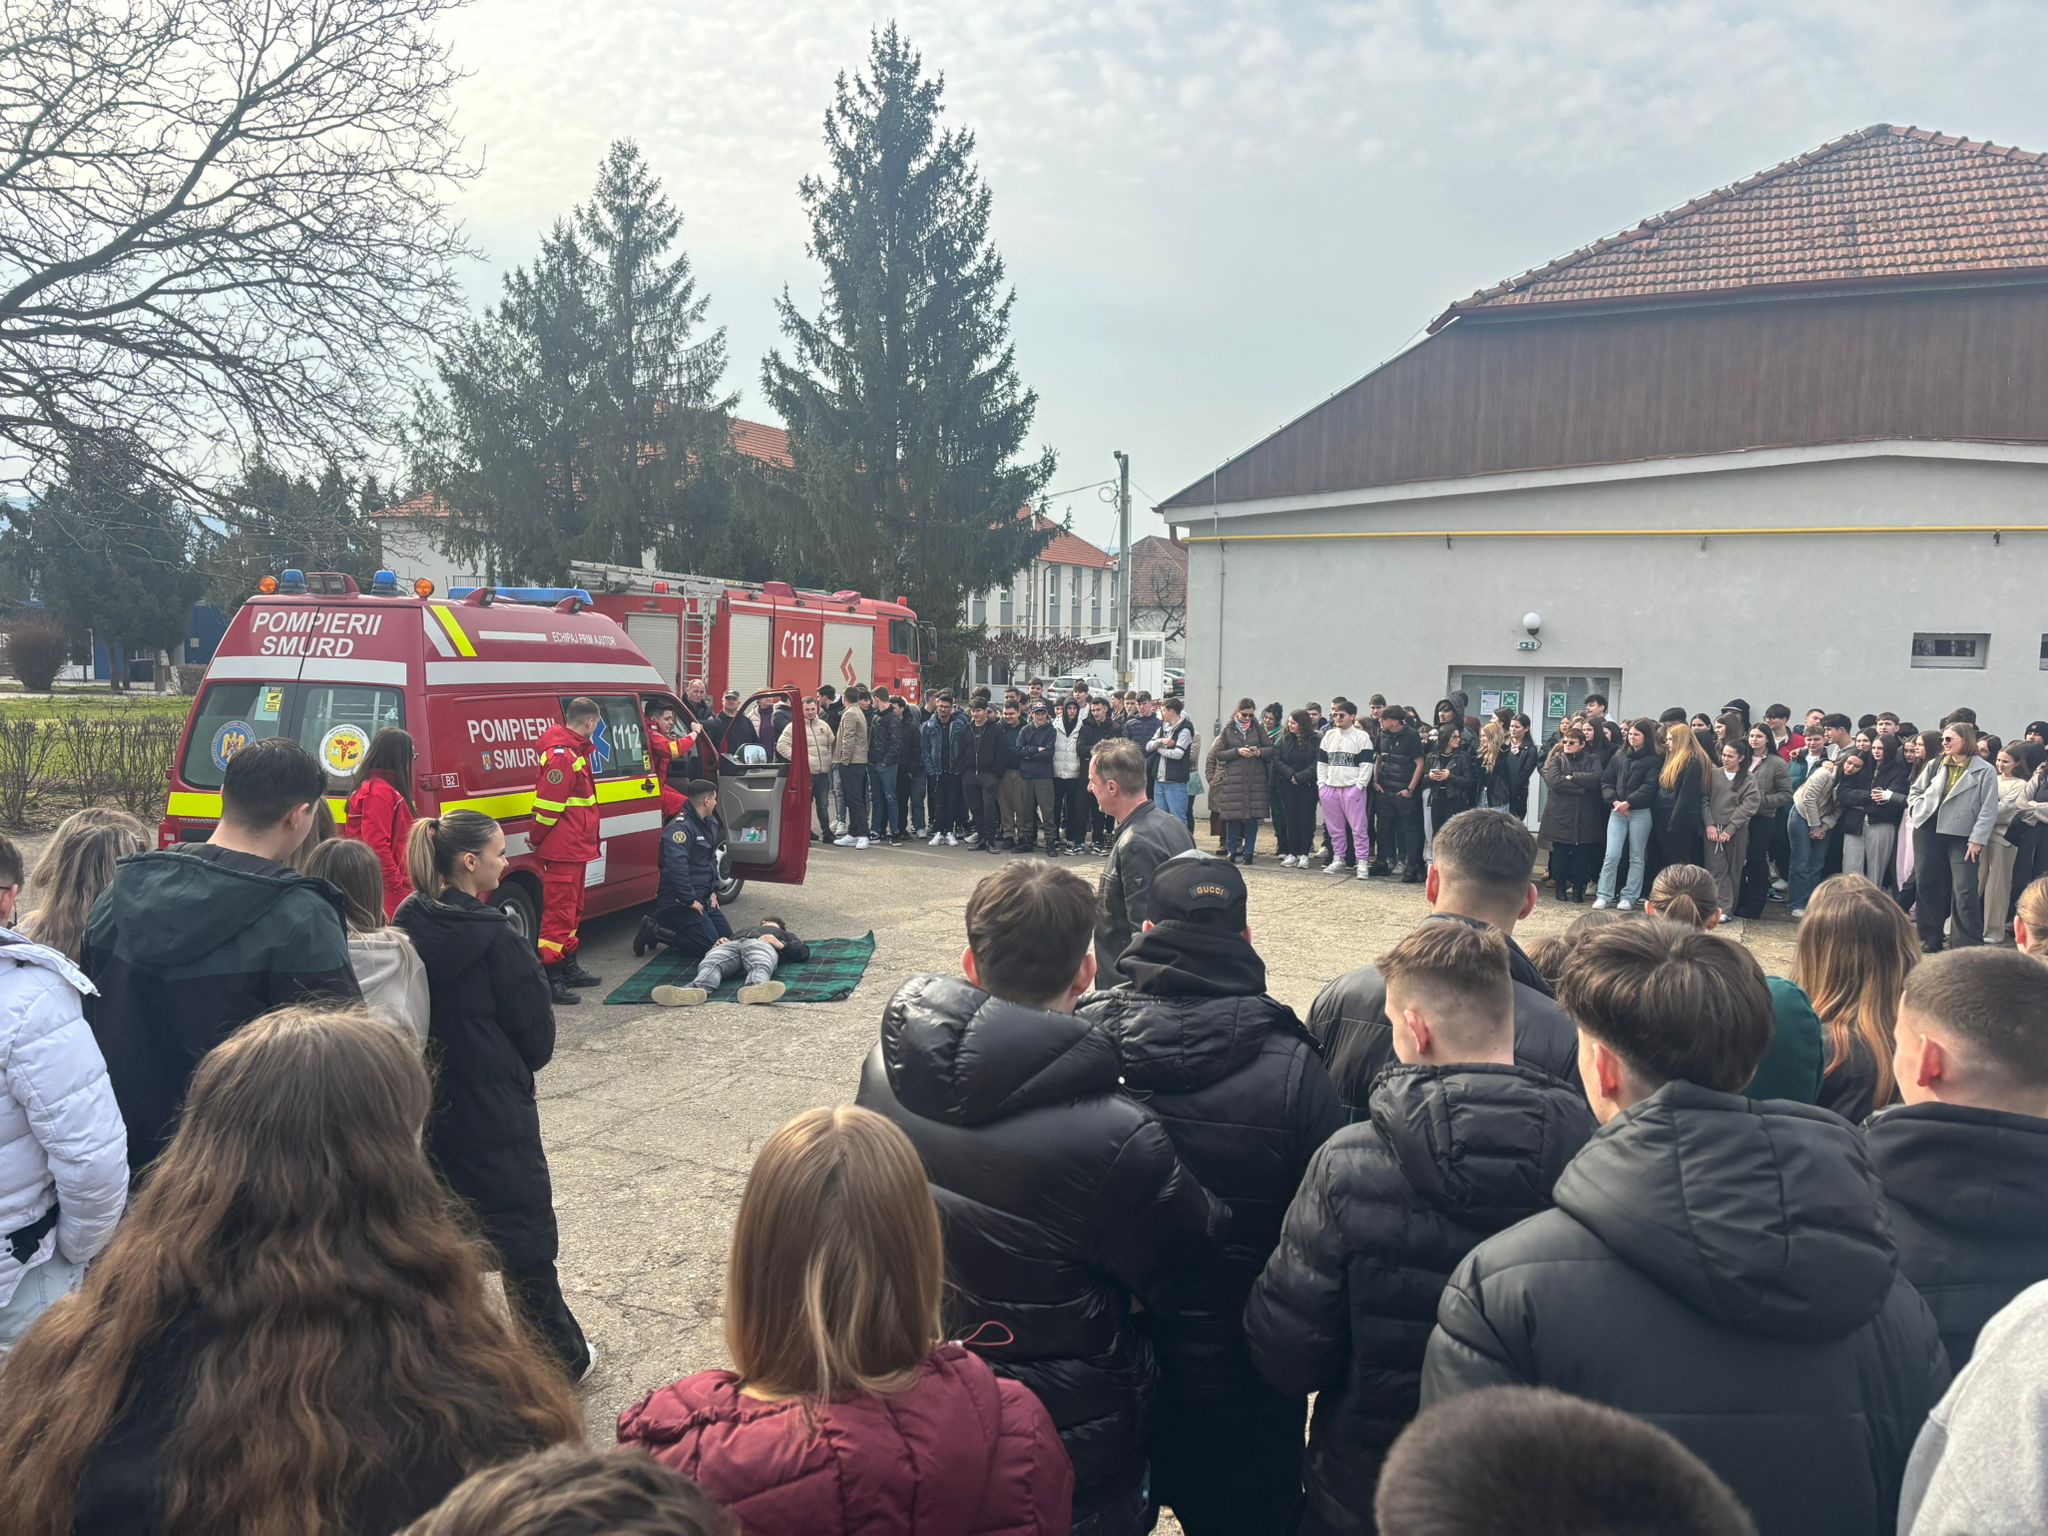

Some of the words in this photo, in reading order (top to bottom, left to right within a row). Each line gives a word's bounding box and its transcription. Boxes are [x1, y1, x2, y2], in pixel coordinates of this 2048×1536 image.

[252, 611, 383, 636] POMPIERII
[260, 635, 354, 658] SMURD
[466, 717, 555, 744] POMPIER
[493, 747, 540, 770] SMUR
[445, 775, 456, 786] B2
[1196, 886, 1224, 896] GUCCI
